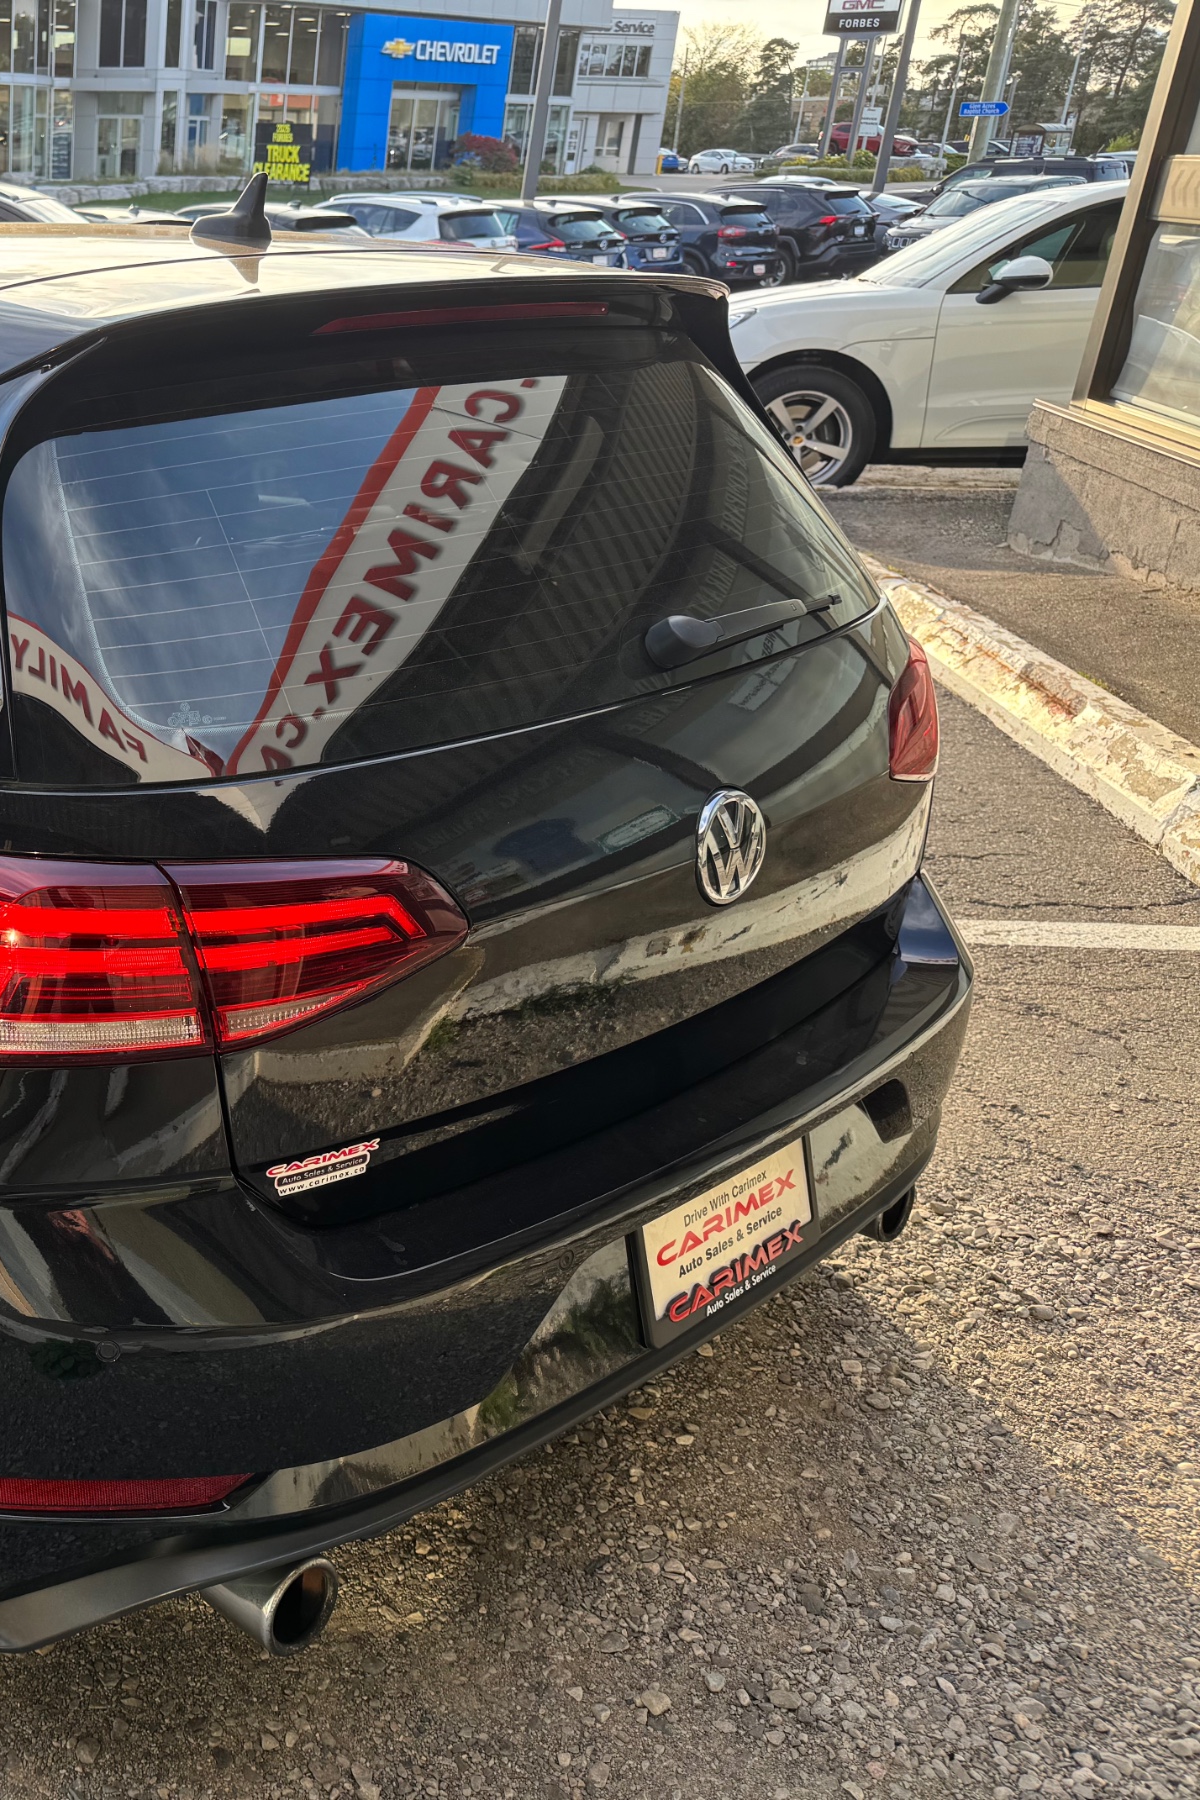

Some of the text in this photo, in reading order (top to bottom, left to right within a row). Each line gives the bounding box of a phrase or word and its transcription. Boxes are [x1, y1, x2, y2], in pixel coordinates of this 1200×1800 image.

[842, 0, 885, 10] GMC
[613, 20, 655, 34] Service
[838, 18, 880, 28] FORBES
[415, 40, 501, 64] CHEVROLET
[266, 145, 301, 163] TRUCK
[253, 162, 311, 182] CLEARANCE
[267, 1139, 379, 1176] CARIMEX
[281, 1174, 302, 1185] Auto
[303, 1169, 325, 1179] Sales
[335, 1157, 363, 1169] Service
[683, 1170, 767, 1228] Drive With Carimex
[657, 1168, 796, 1266] CARIMEX
[679, 1205, 782, 1279] Auto Sales & Service
[668, 1222, 804, 1322] CARIMEX
[706, 1264, 777, 1317] Auto Sales & Service
